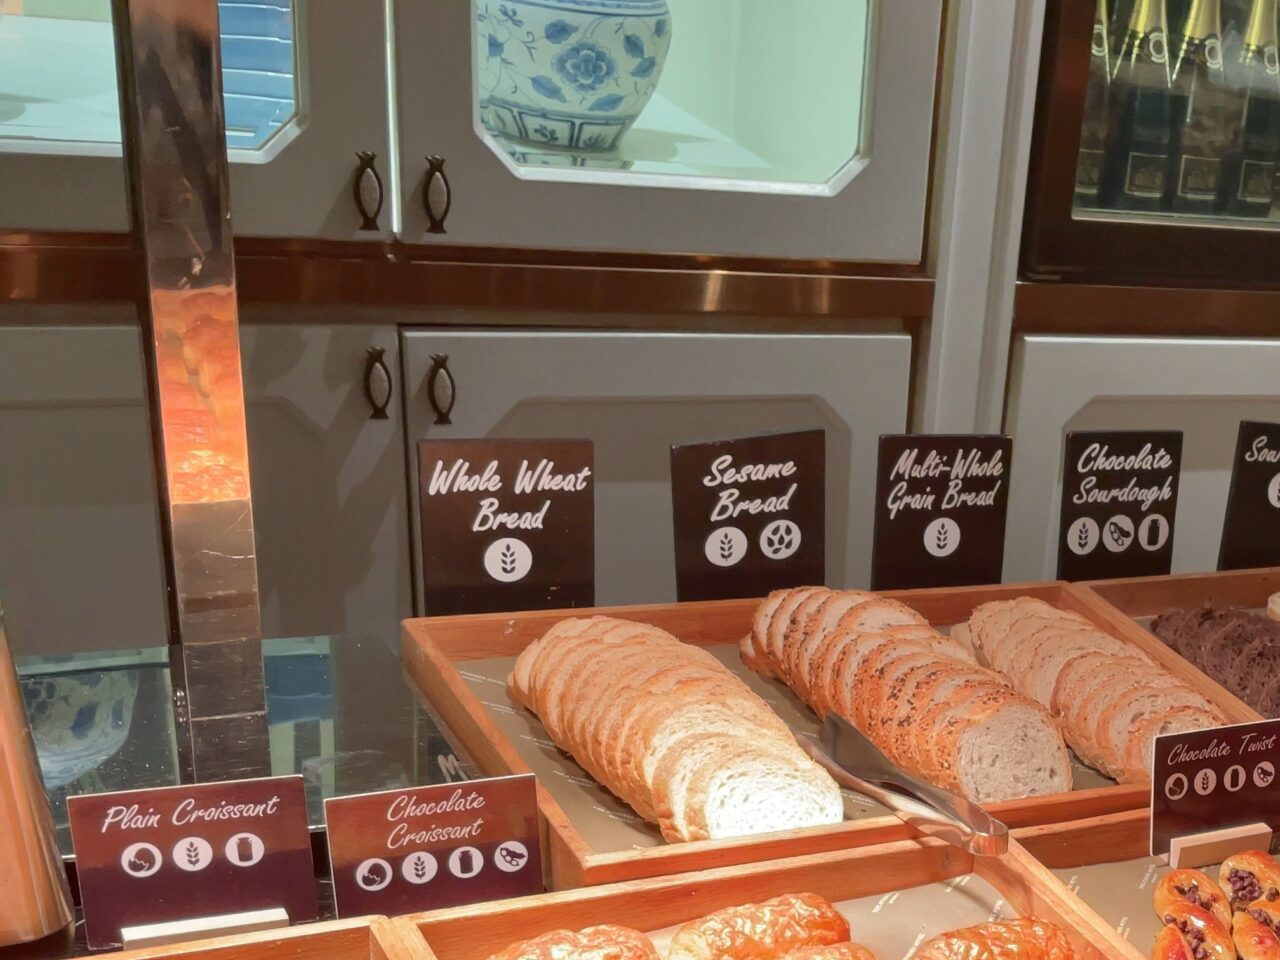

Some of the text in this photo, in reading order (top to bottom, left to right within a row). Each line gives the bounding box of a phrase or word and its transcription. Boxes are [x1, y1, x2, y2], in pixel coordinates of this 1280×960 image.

[703, 454, 797, 486] Sesame
[890, 448, 1004, 480] Multi-Whole
[1077, 442, 1173, 473] Chocolate
[428, 459, 592, 495] Whole Wheat
[1072, 476, 1173, 511] Sourdough
[472, 497, 551, 532] Bread
[710, 483, 798, 522] Bread
[887, 479, 1001, 520] Grain Bread
[1167, 733, 1278, 765] Chocolate Twist
[102, 795, 281, 833] Plain Croissant
[386, 788, 486, 822] Chocolate
[386, 818, 485, 850] Croissant
